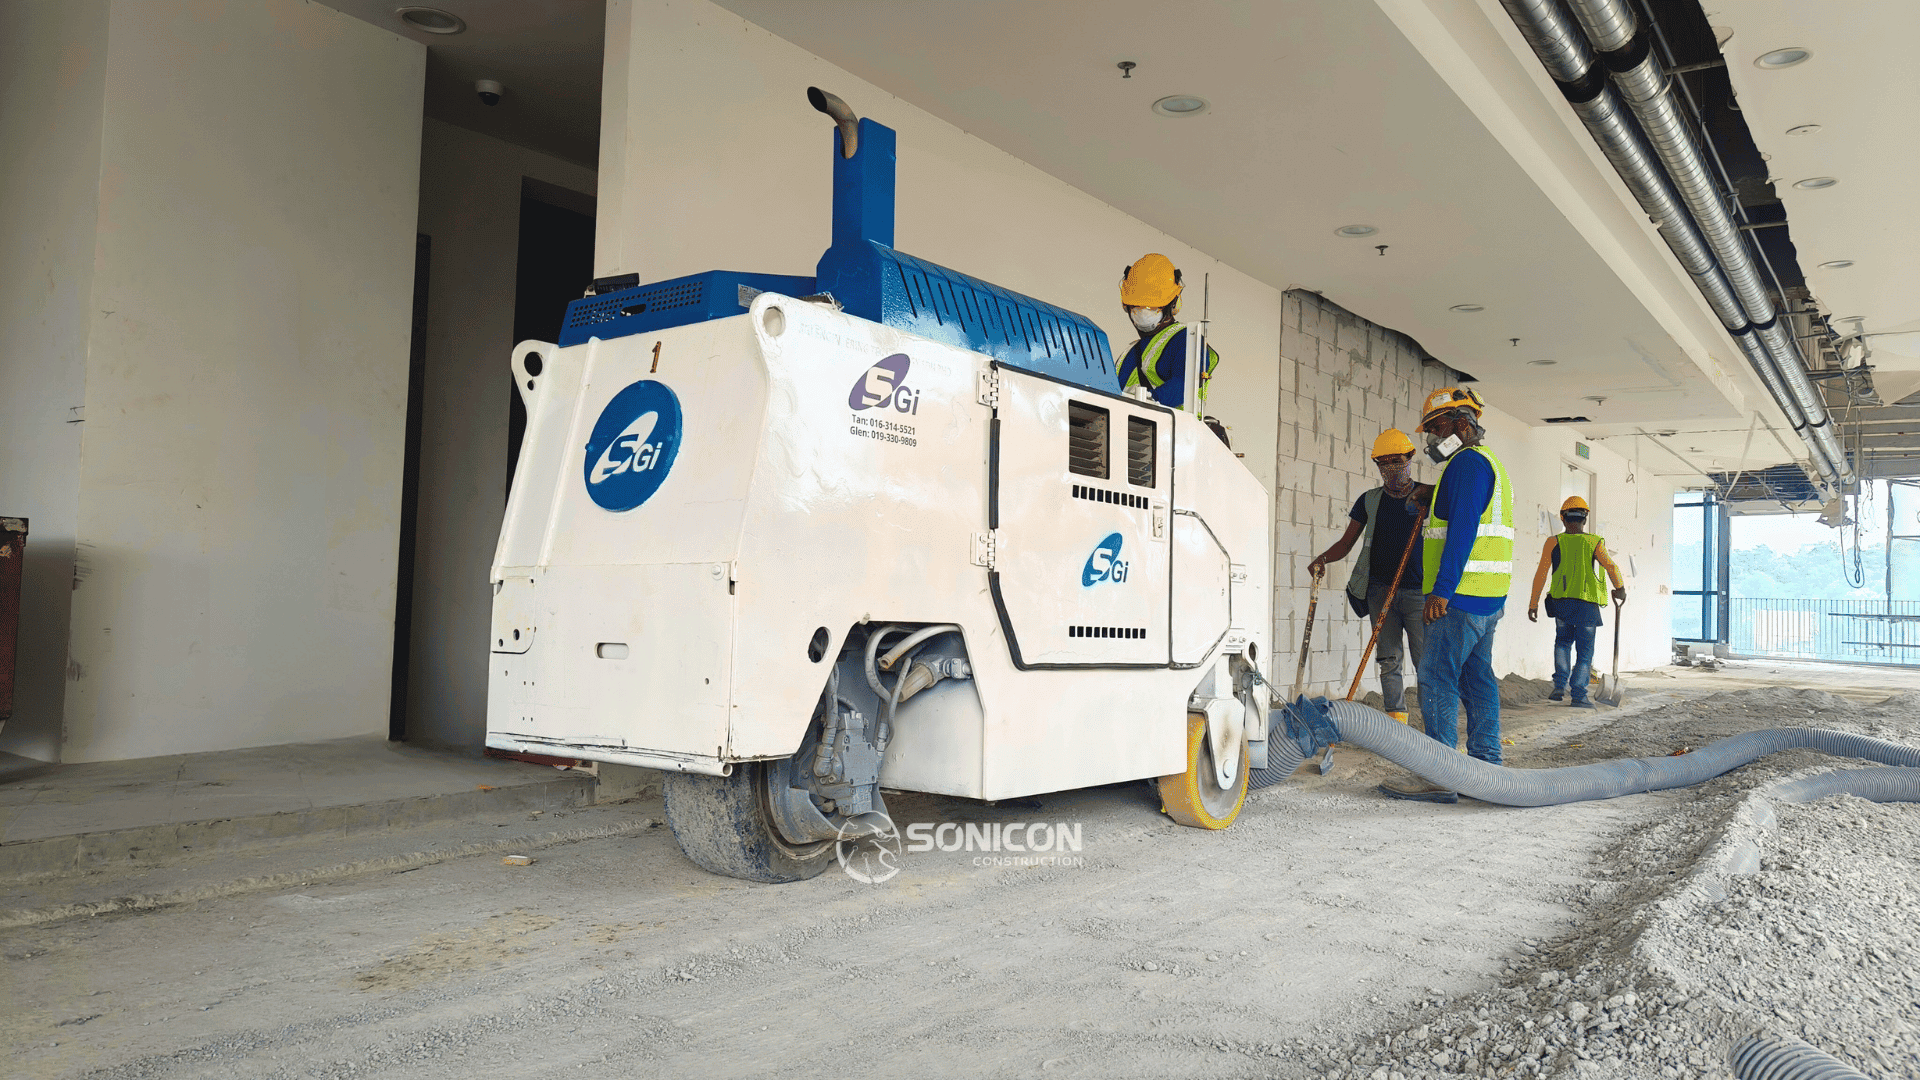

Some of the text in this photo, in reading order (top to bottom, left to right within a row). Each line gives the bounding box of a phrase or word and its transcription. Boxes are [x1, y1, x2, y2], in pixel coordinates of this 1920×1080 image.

[650, 340, 662, 373] 1
[861, 365, 920, 415] SGi
[850, 426, 917, 447] Glen: 019-330-9809
[851, 413, 915, 435] Tan: 016-314-5521
[600, 430, 663, 477] SGi
[1089, 546, 1129, 583] SGi
